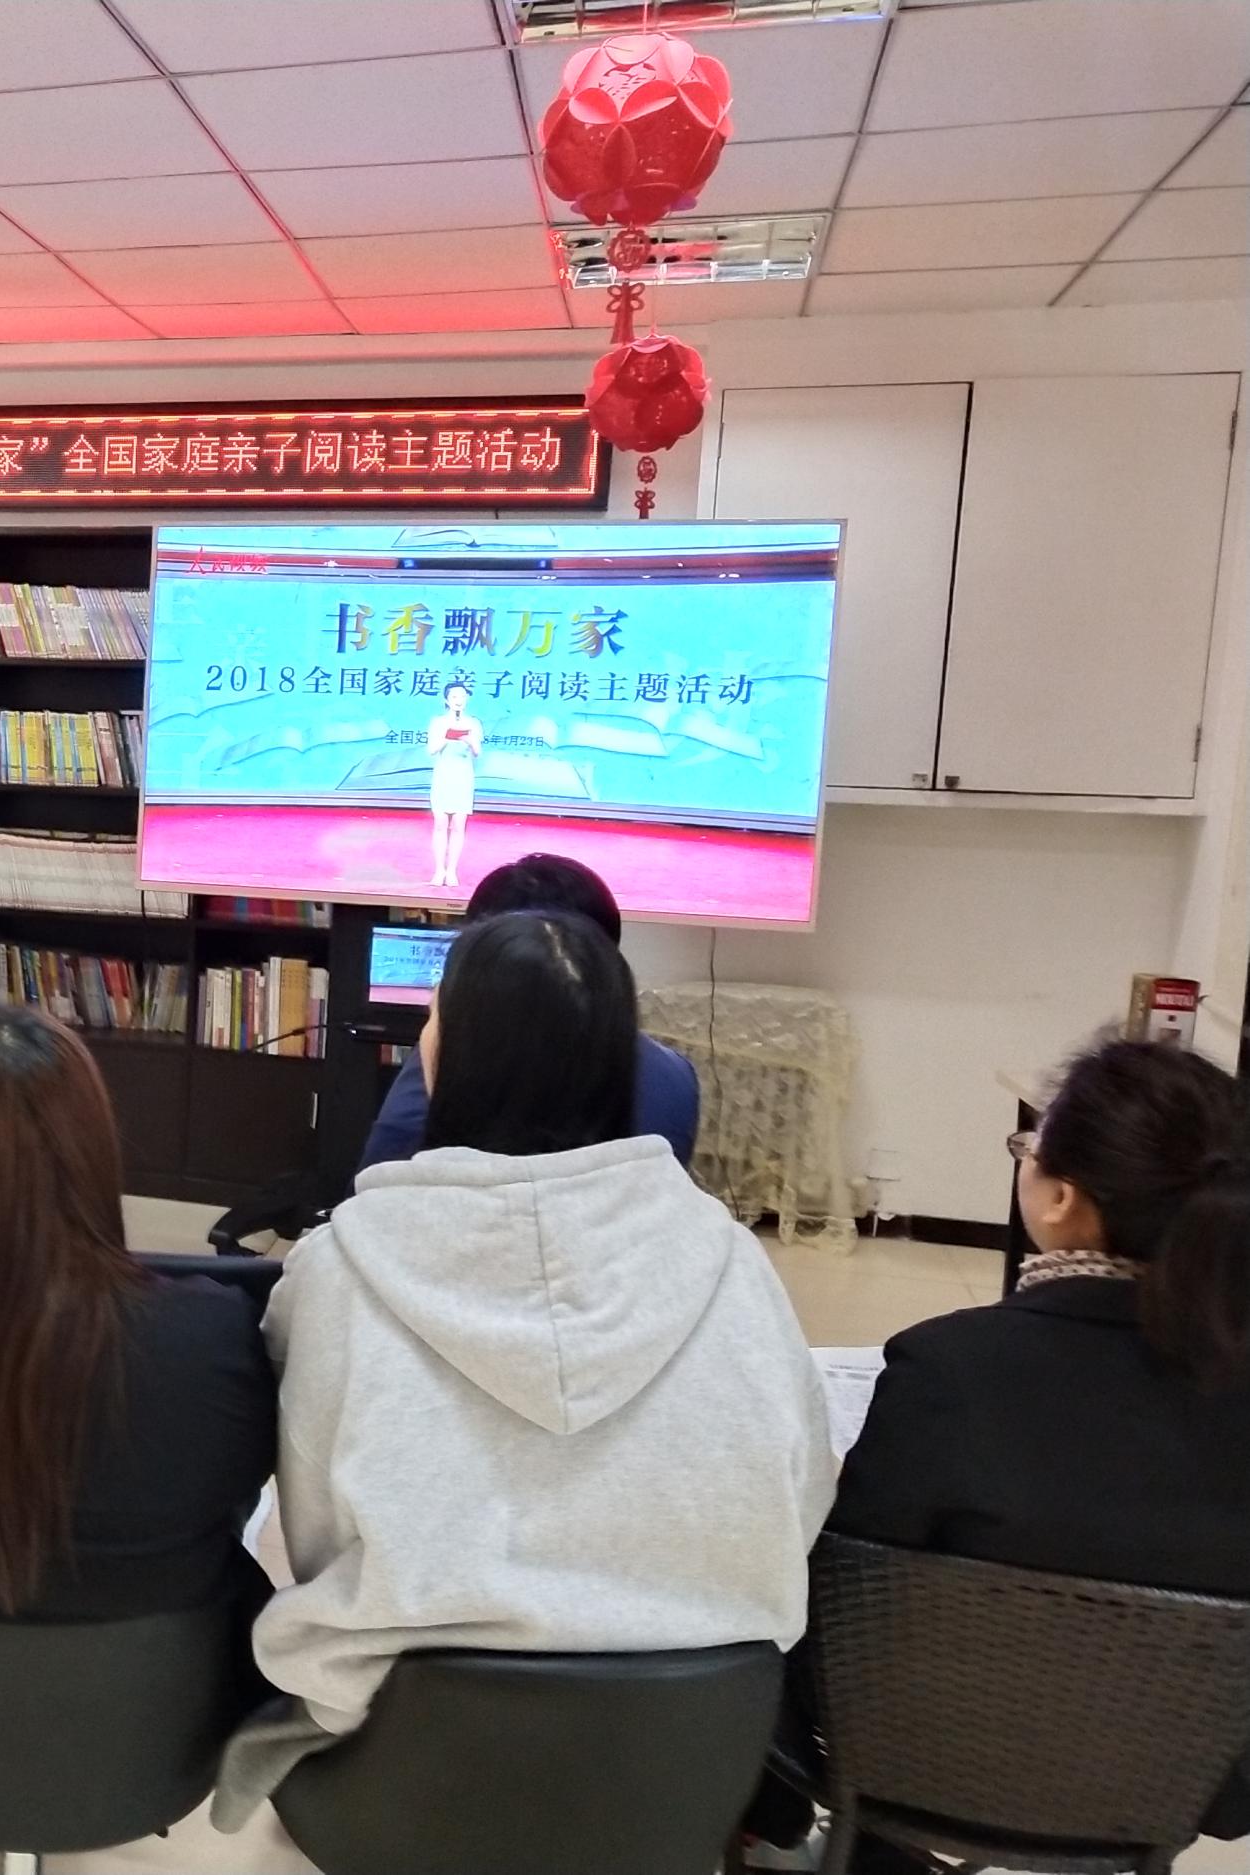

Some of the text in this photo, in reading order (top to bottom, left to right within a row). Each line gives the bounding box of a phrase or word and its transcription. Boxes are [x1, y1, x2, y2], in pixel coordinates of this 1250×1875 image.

[321, 602, 628, 659] 书香飘万家
